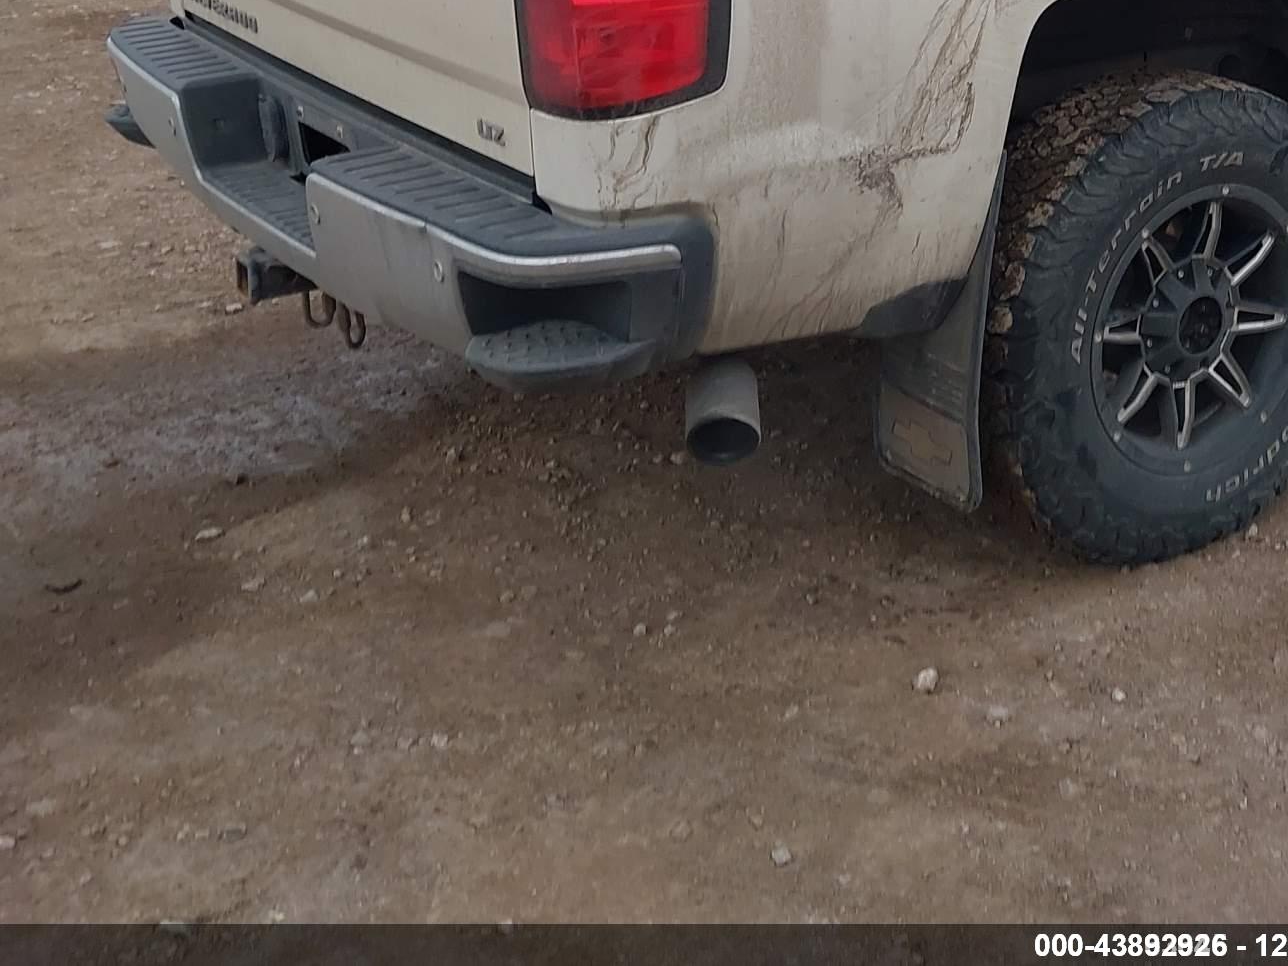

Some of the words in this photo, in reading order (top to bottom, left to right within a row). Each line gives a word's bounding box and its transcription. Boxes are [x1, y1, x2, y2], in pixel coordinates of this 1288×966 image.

[476, 118, 506, 147] LTZ
[1071, 171, 1183, 365] All-Terrain
[1200, 151, 1245, 172] T/A
